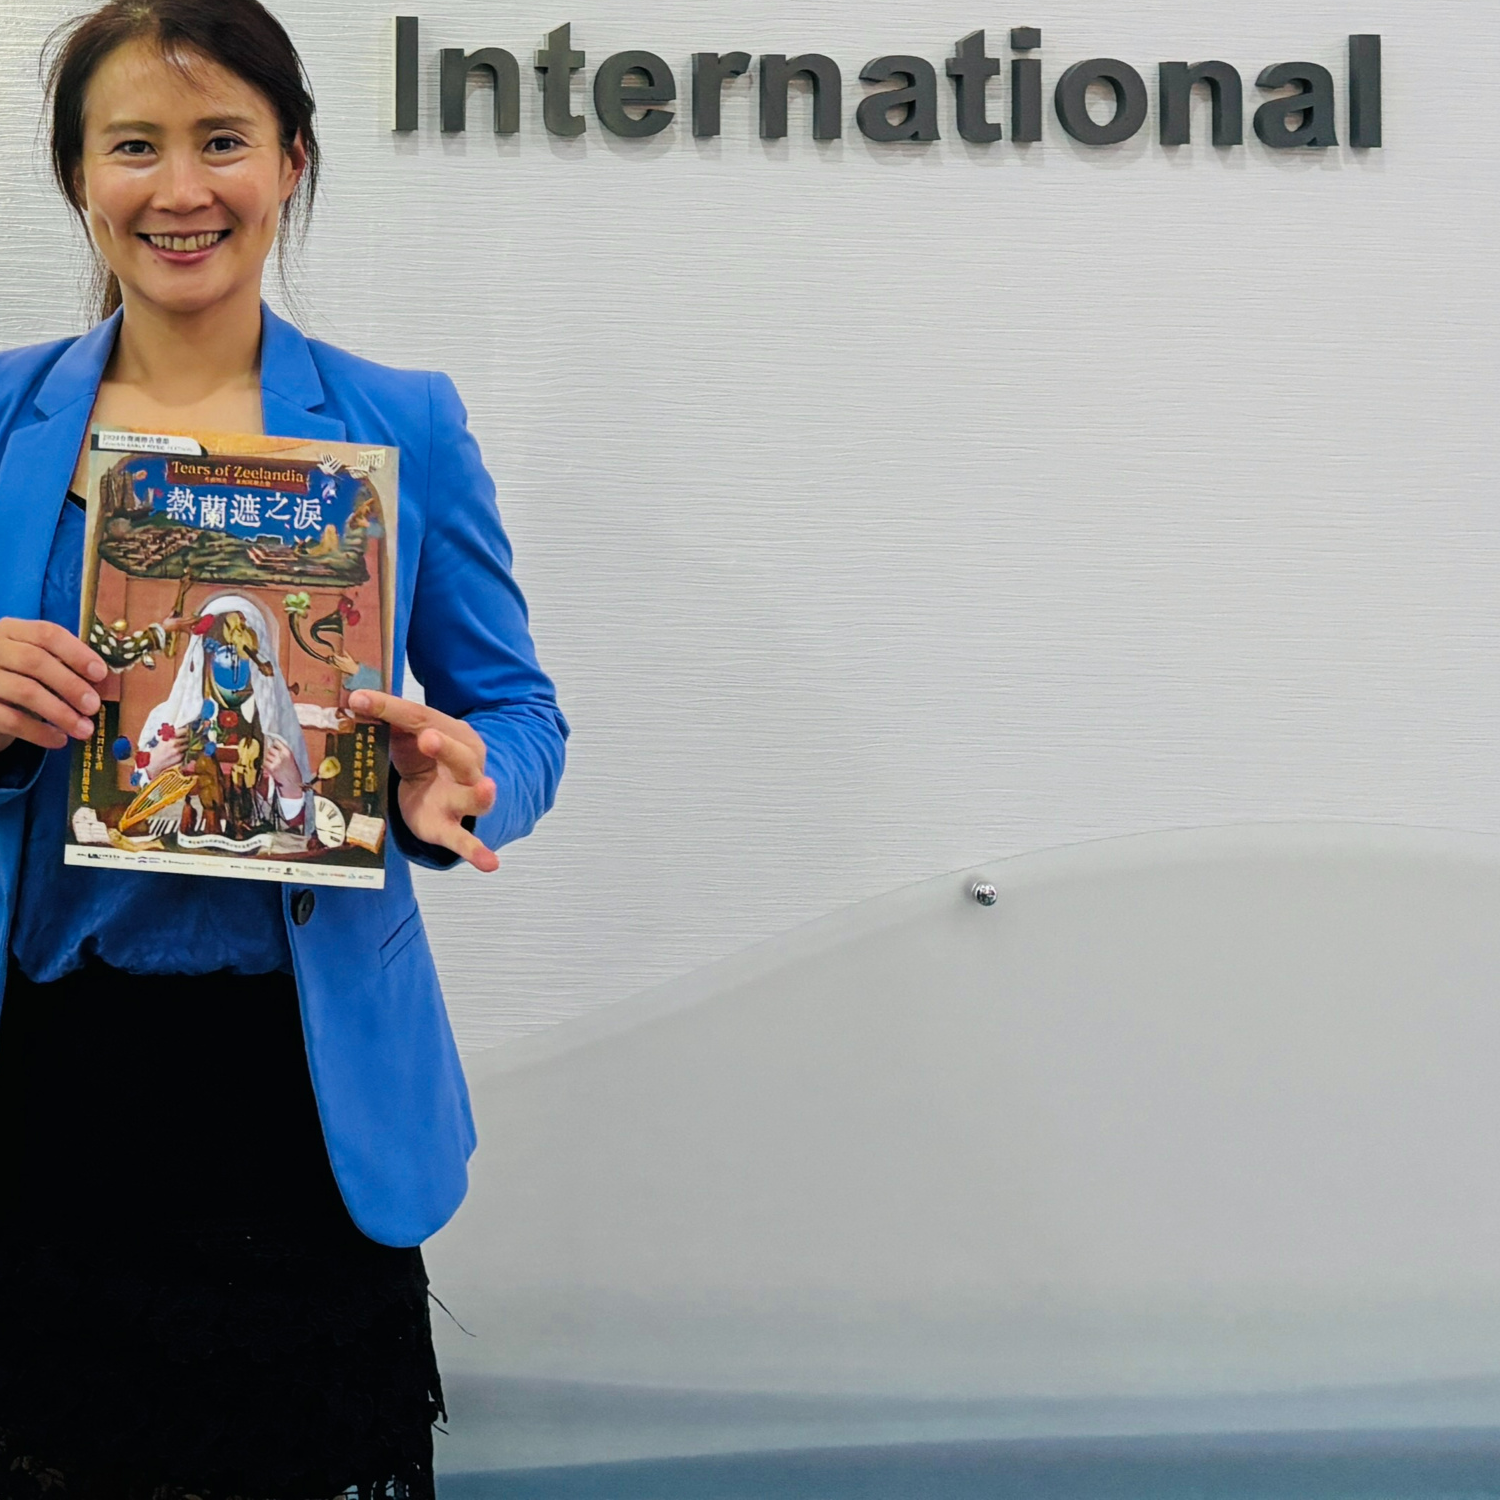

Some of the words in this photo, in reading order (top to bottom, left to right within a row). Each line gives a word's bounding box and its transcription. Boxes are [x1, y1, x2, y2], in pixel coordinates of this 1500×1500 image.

[392, 16, 1383, 149] International
[171, 461, 211, 476] Tears
[214, 464, 231, 477] of
[233, 466, 306, 483] Zeelandia
[166, 486, 323, 531] 熱蘭遮之淚
